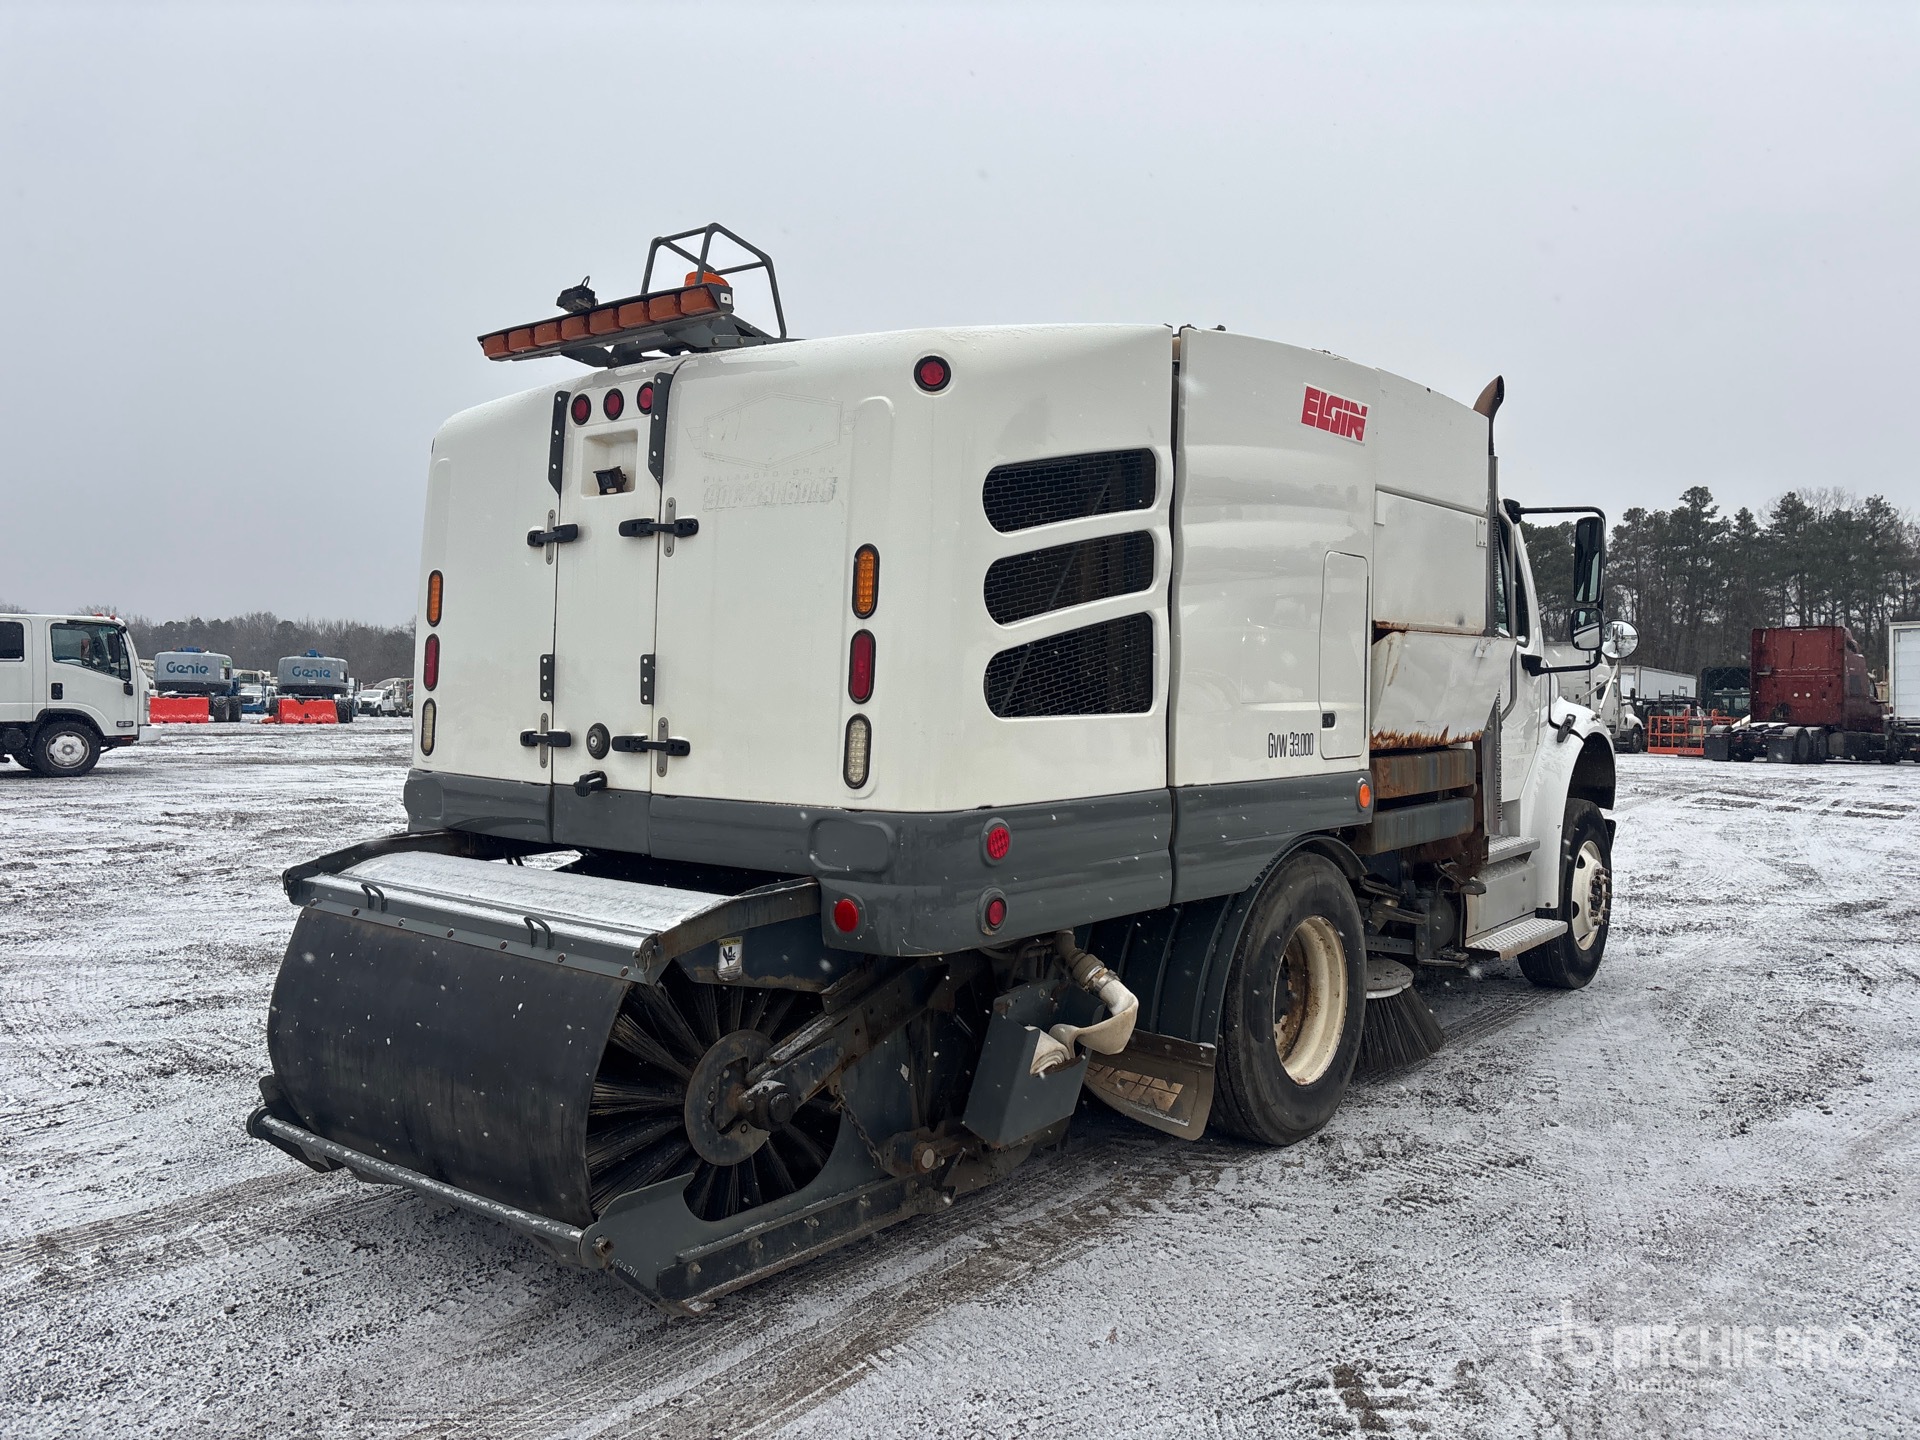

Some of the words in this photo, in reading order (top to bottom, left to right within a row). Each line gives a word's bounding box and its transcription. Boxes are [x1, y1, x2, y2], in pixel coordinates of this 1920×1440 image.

[1301, 386, 1368, 442] ELGIN
[166, 661, 209, 675] Genie
[292, 666, 331, 678] Genie
[1268, 732, 1288, 759] GVW
[1289, 731, 1314, 758] 33,000
